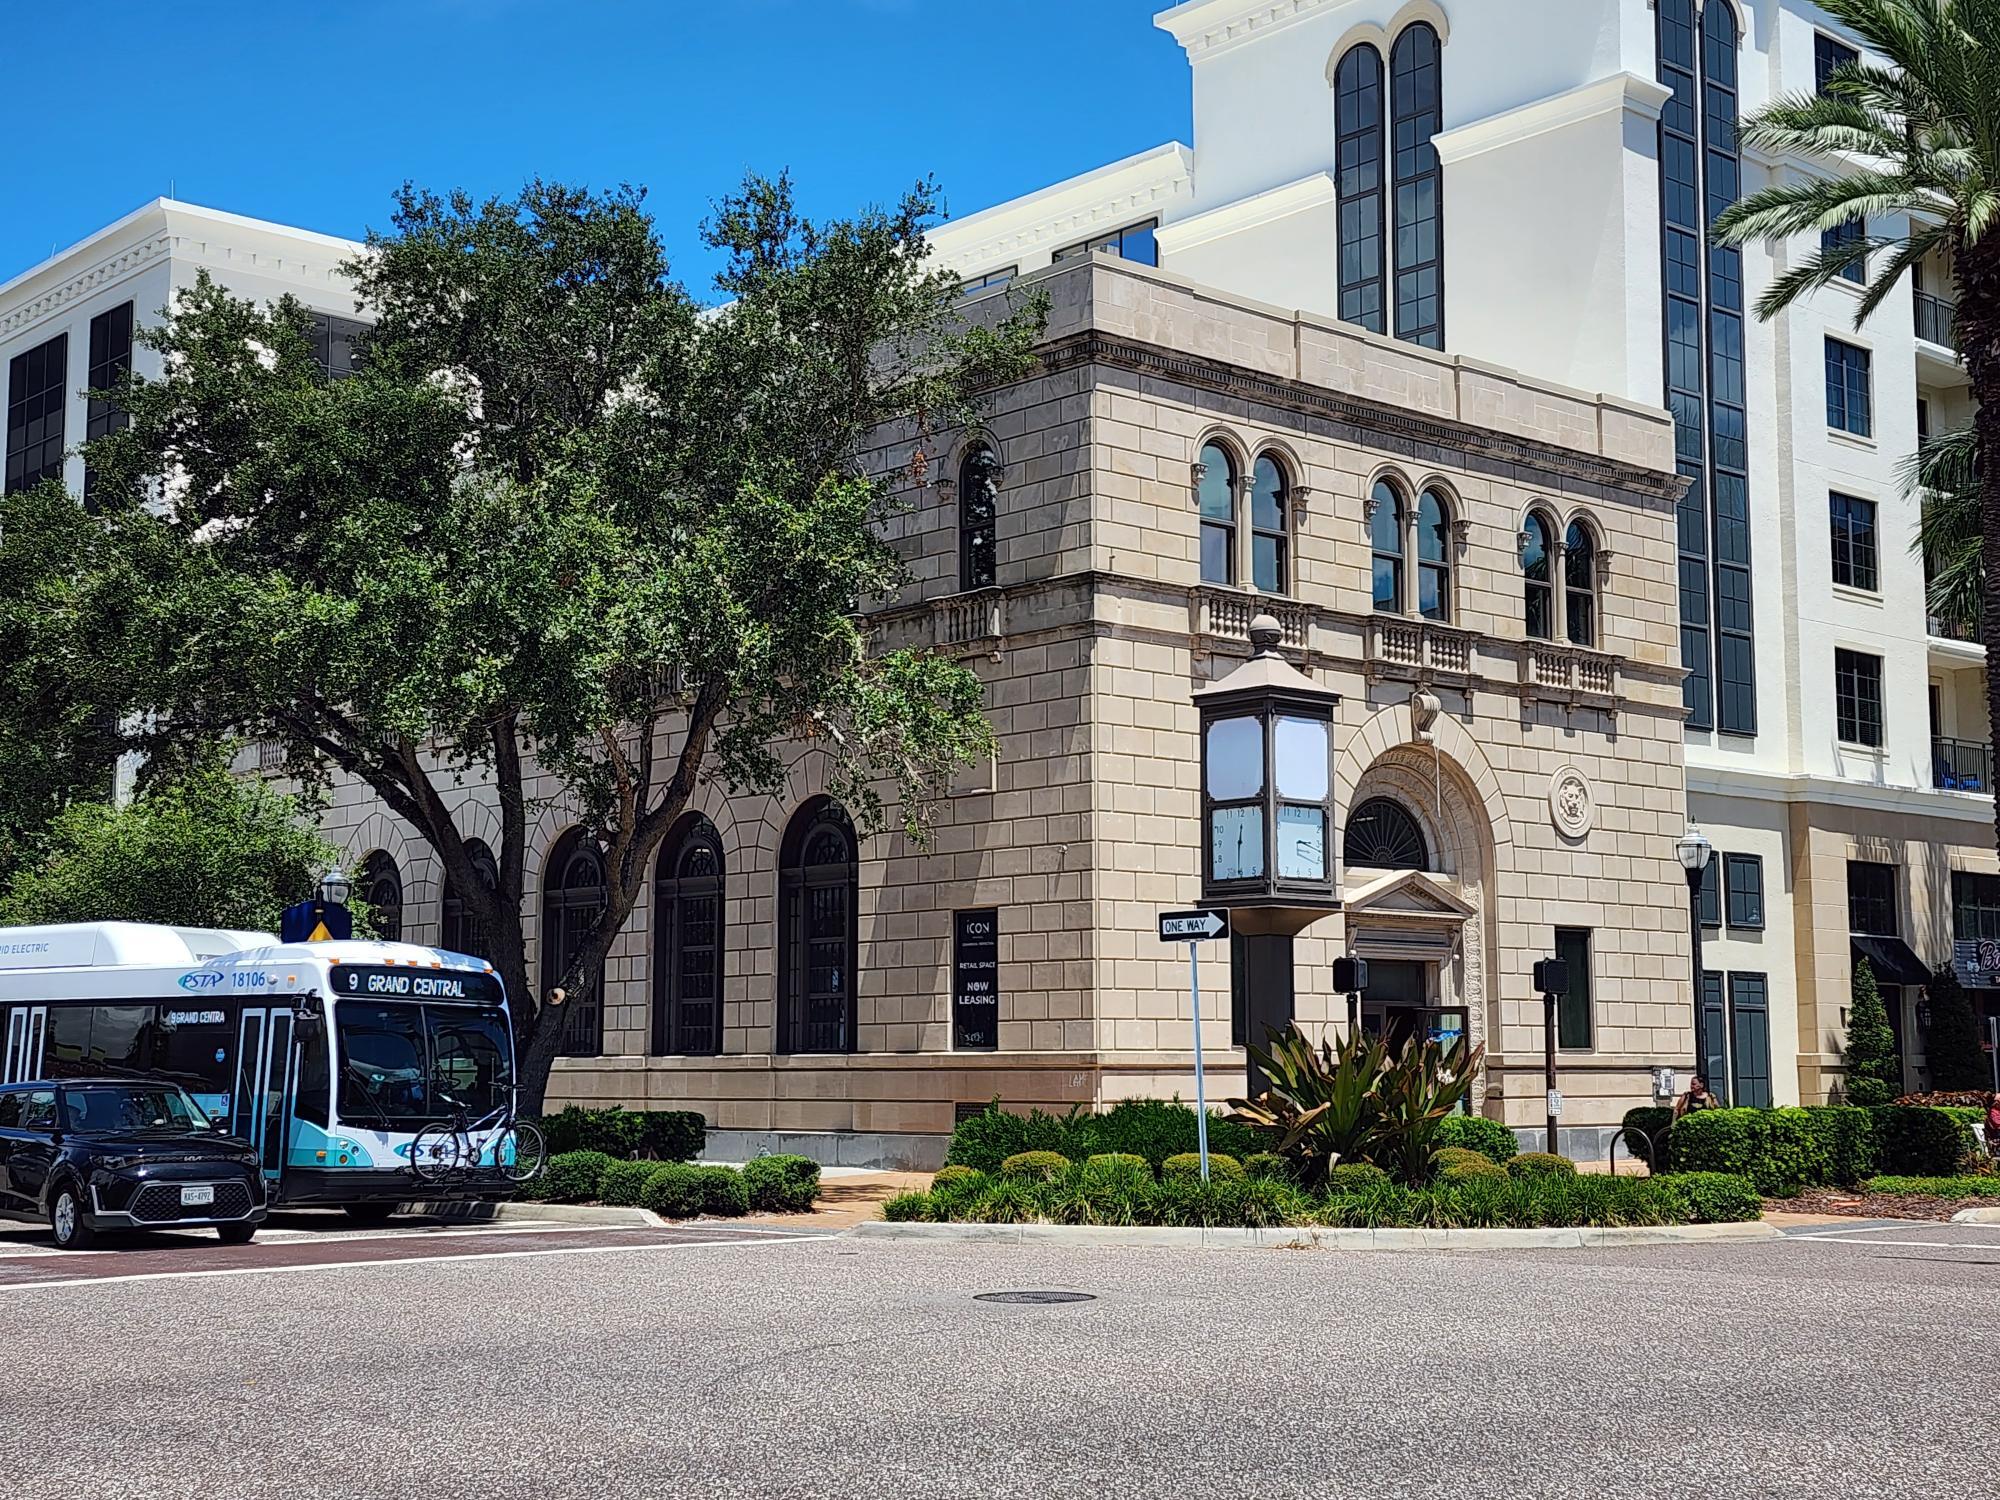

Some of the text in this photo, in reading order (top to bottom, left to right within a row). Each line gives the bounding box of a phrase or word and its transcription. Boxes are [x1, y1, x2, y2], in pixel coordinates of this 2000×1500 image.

[1237, 809, 1245, 818] 12
[1294, 808, 1301, 818] 12
[1165, 919, 1206, 933] ONE WAY
[11, 943, 49, 954] ELECTRIC
[978, 961, 996, 969] SPACE
[181, 972, 224, 989] PSTA
[231, 972, 265, 988] 18106
[348, 973, 466, 998] 9 GRAND CENTRAL
[967, 981, 989, 991] NOW
[959, 995, 996, 1005] LEASING
[175, 1011, 199, 1024] GRAND
[199, 1010, 225, 1023] CENTRA
